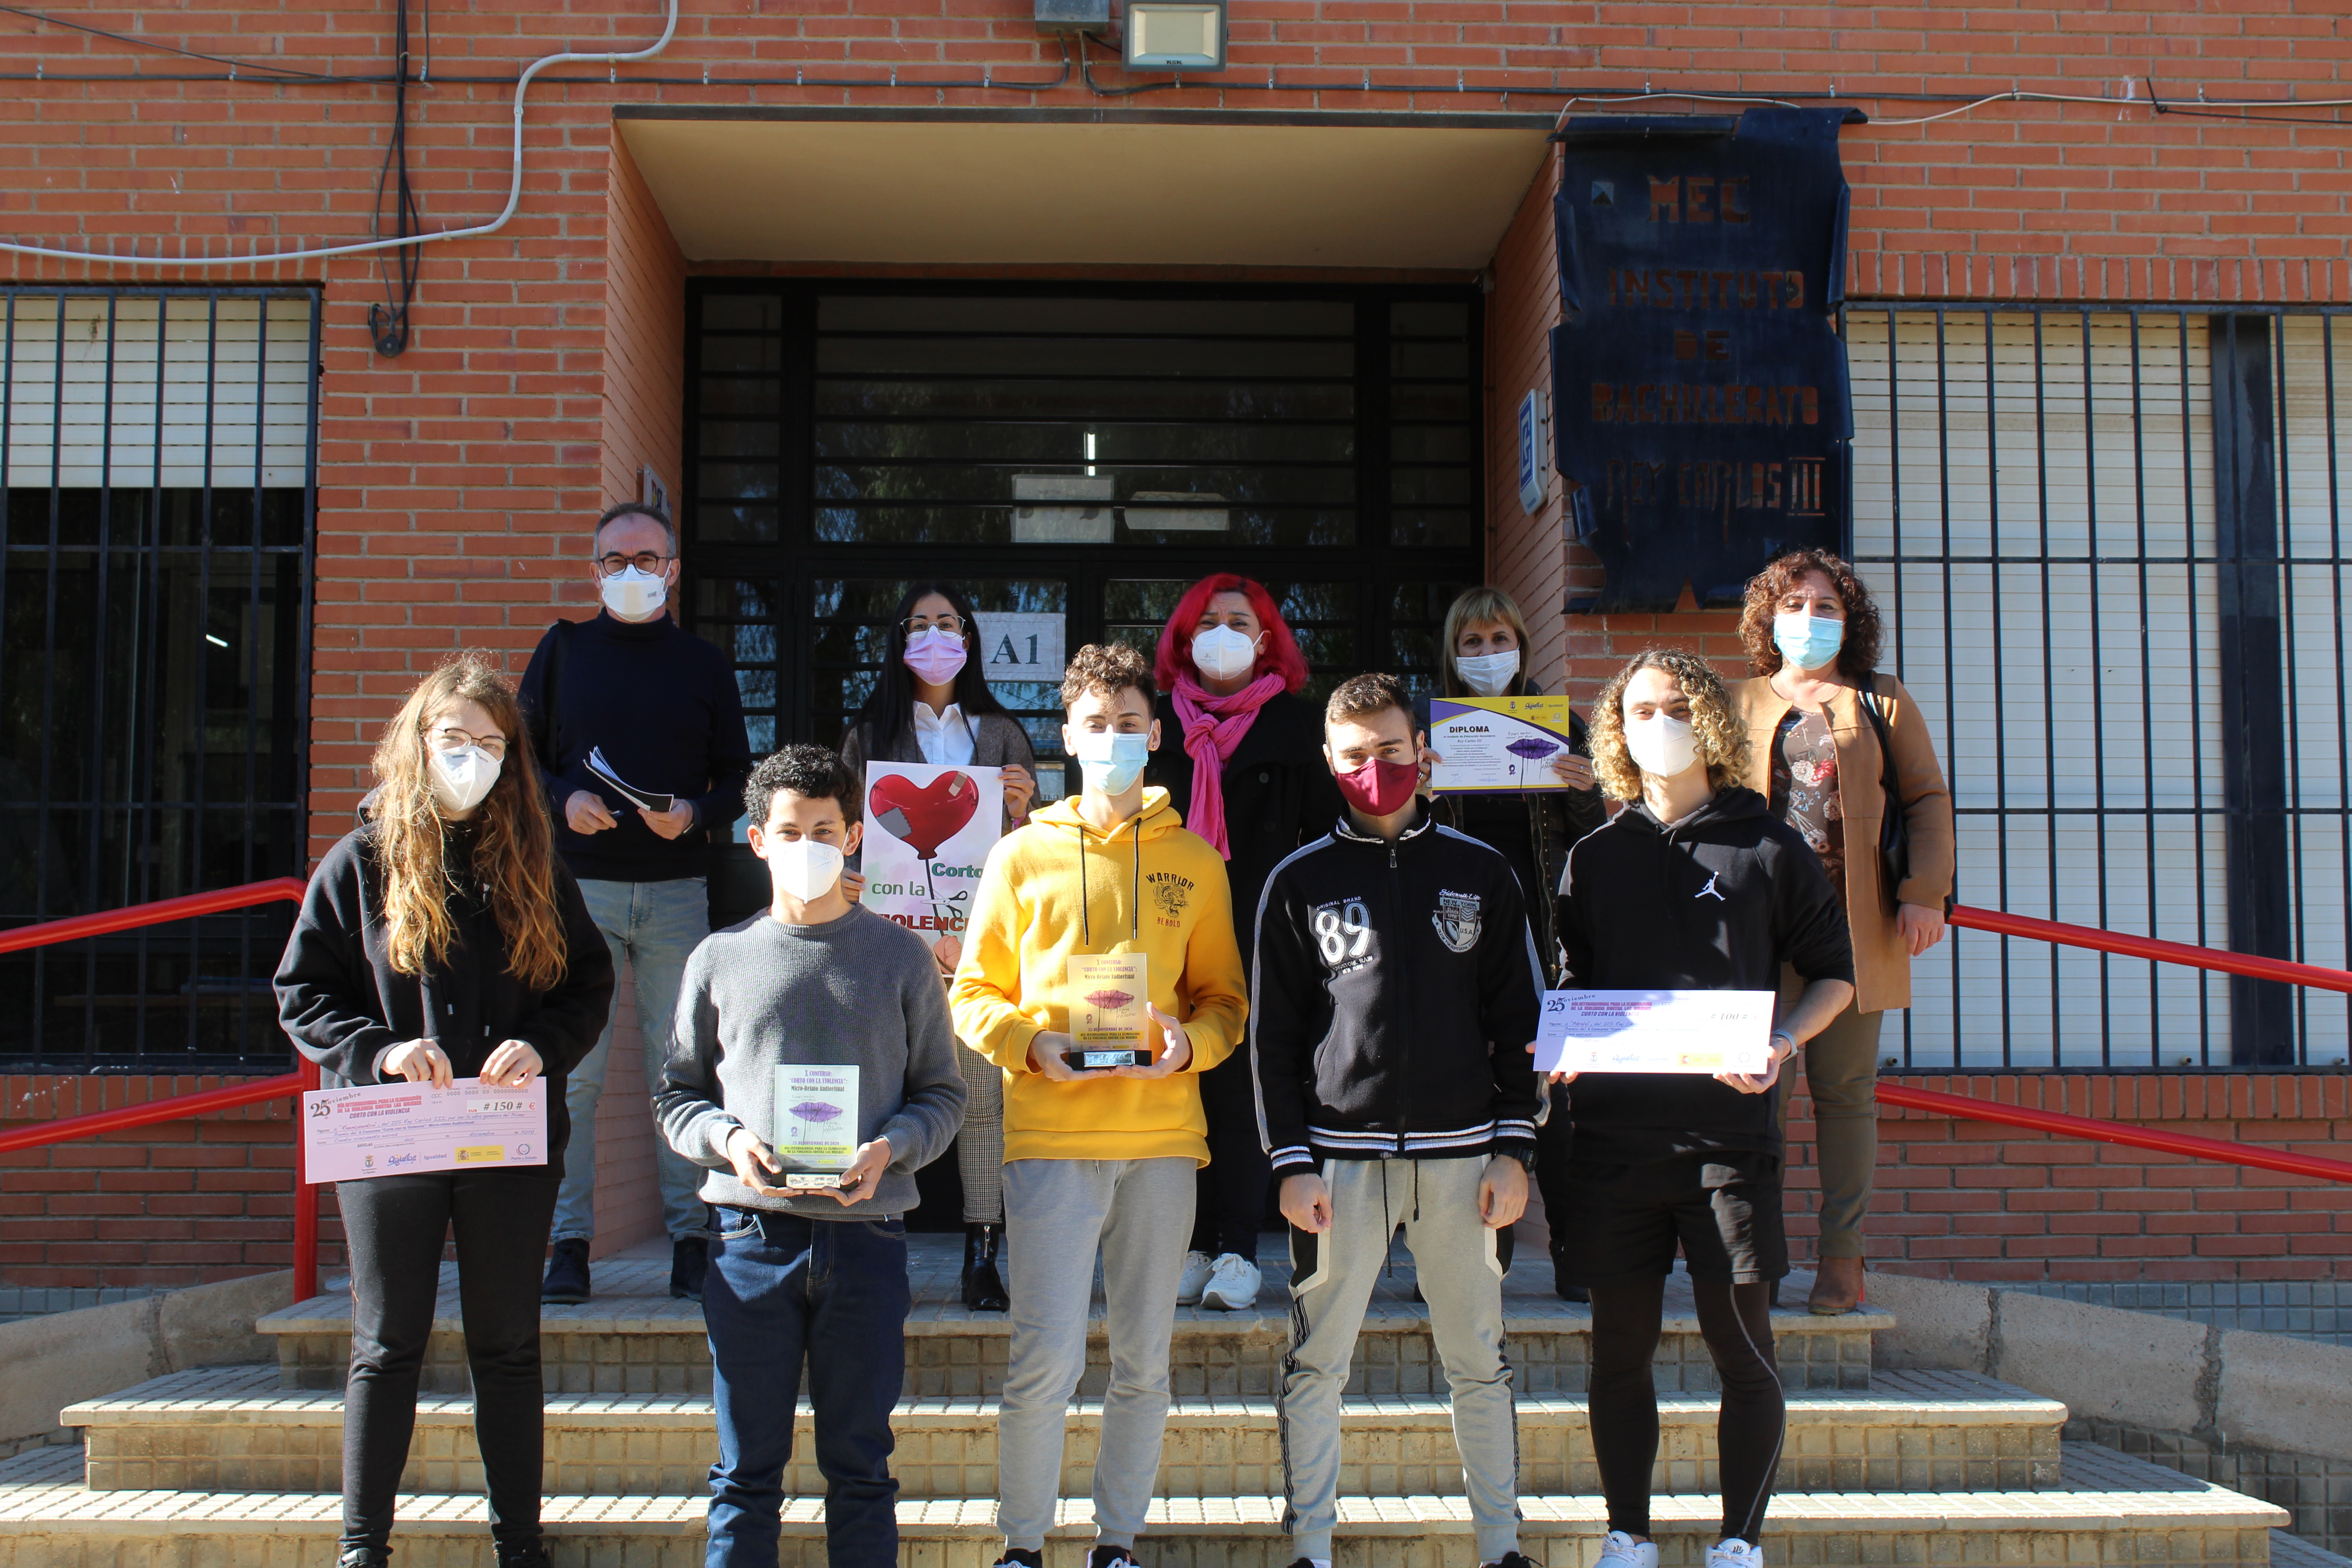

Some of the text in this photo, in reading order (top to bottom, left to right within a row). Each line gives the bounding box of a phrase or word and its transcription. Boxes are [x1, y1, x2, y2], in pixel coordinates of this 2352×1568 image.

[1648, 175, 1749, 224] MEC
[1609, 269, 1804, 310] INSTITUTO
[1675, 330, 1730, 360] DE
[1592, 383, 1819, 424] BACHILLERATO
[1606, 457, 1826, 540] REY CARLOS III
[990, 633, 1041, 664] A1
[931, 862, 984, 878] Corto
[872, 881, 925, 896] con la
[1146, 872, 1194, 891] WARRIOR
[1317, 900, 1340, 911] ORIGINAL
[1157, 917, 1180, 928] BE BOLD
[1315, 901, 1372, 965] 89
[1359, 955, 1373, 963] RAW
[1547, 994, 1596, 1012] 25 noviembre
[310, 1091, 362, 1118] 25 noviembre
[385, 1107, 410, 1115] VIOLENCIA
[484, 1102, 490, 1111] #
[493, 1101, 514, 1111] 150
[516, 1101, 523, 1110] #
[529, 1102, 536, 1110] €
[424, 1152, 447, 1161] Igualdad
